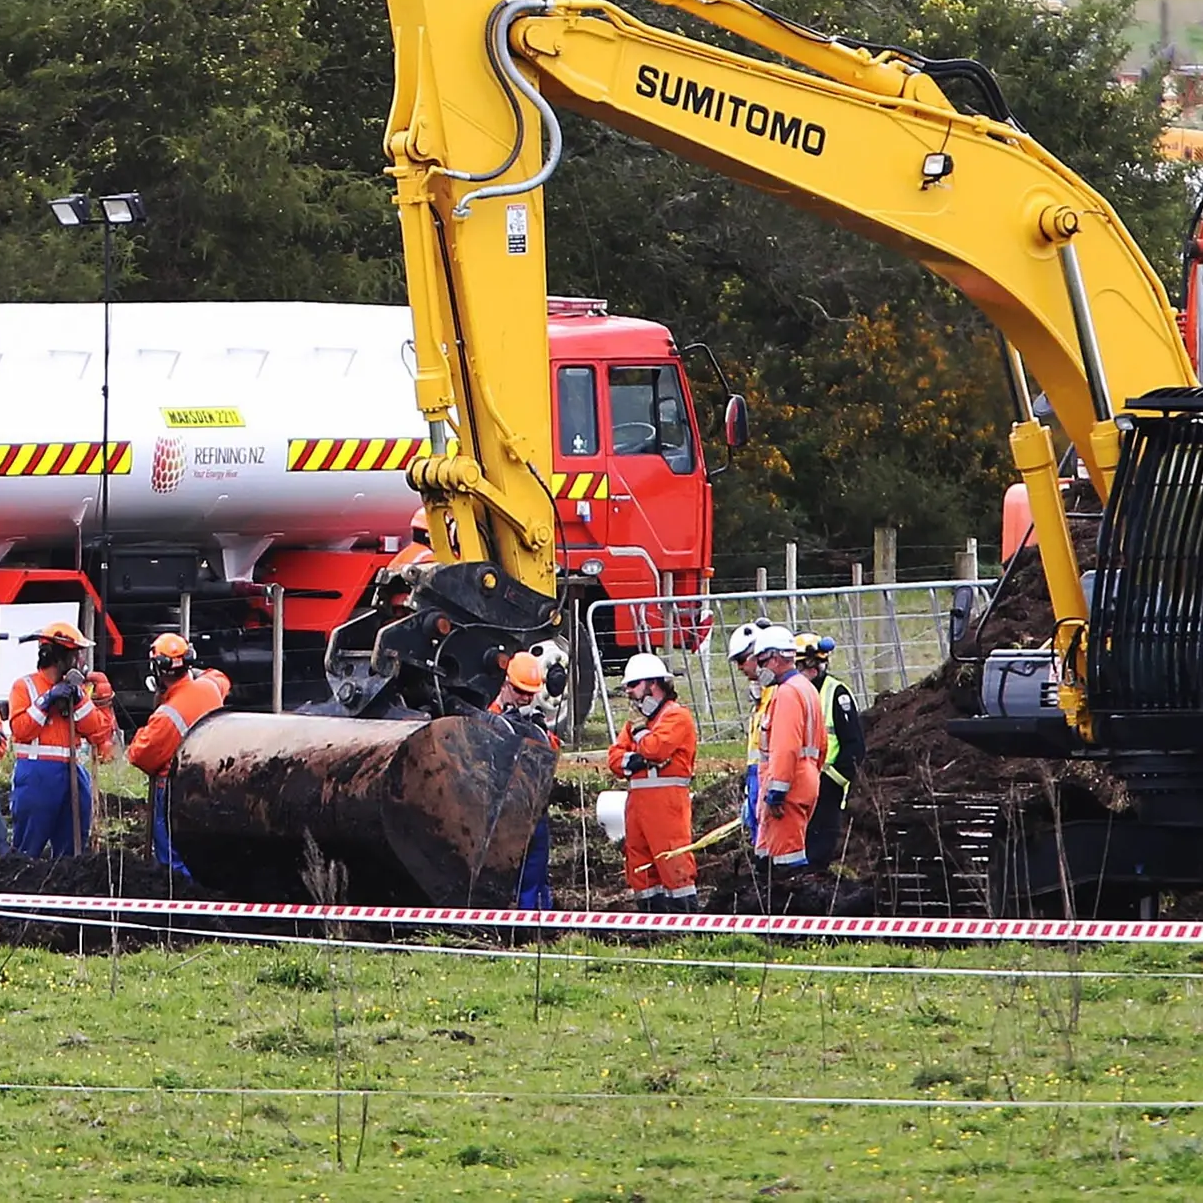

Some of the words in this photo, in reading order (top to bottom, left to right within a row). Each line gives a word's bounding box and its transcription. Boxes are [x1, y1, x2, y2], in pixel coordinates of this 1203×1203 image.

[635, 64, 826, 156] SUMITOMO
[167, 410, 215, 424] MARSDEN
[194, 447, 247, 465] REFINING
[248, 446, 266, 464] NZ
